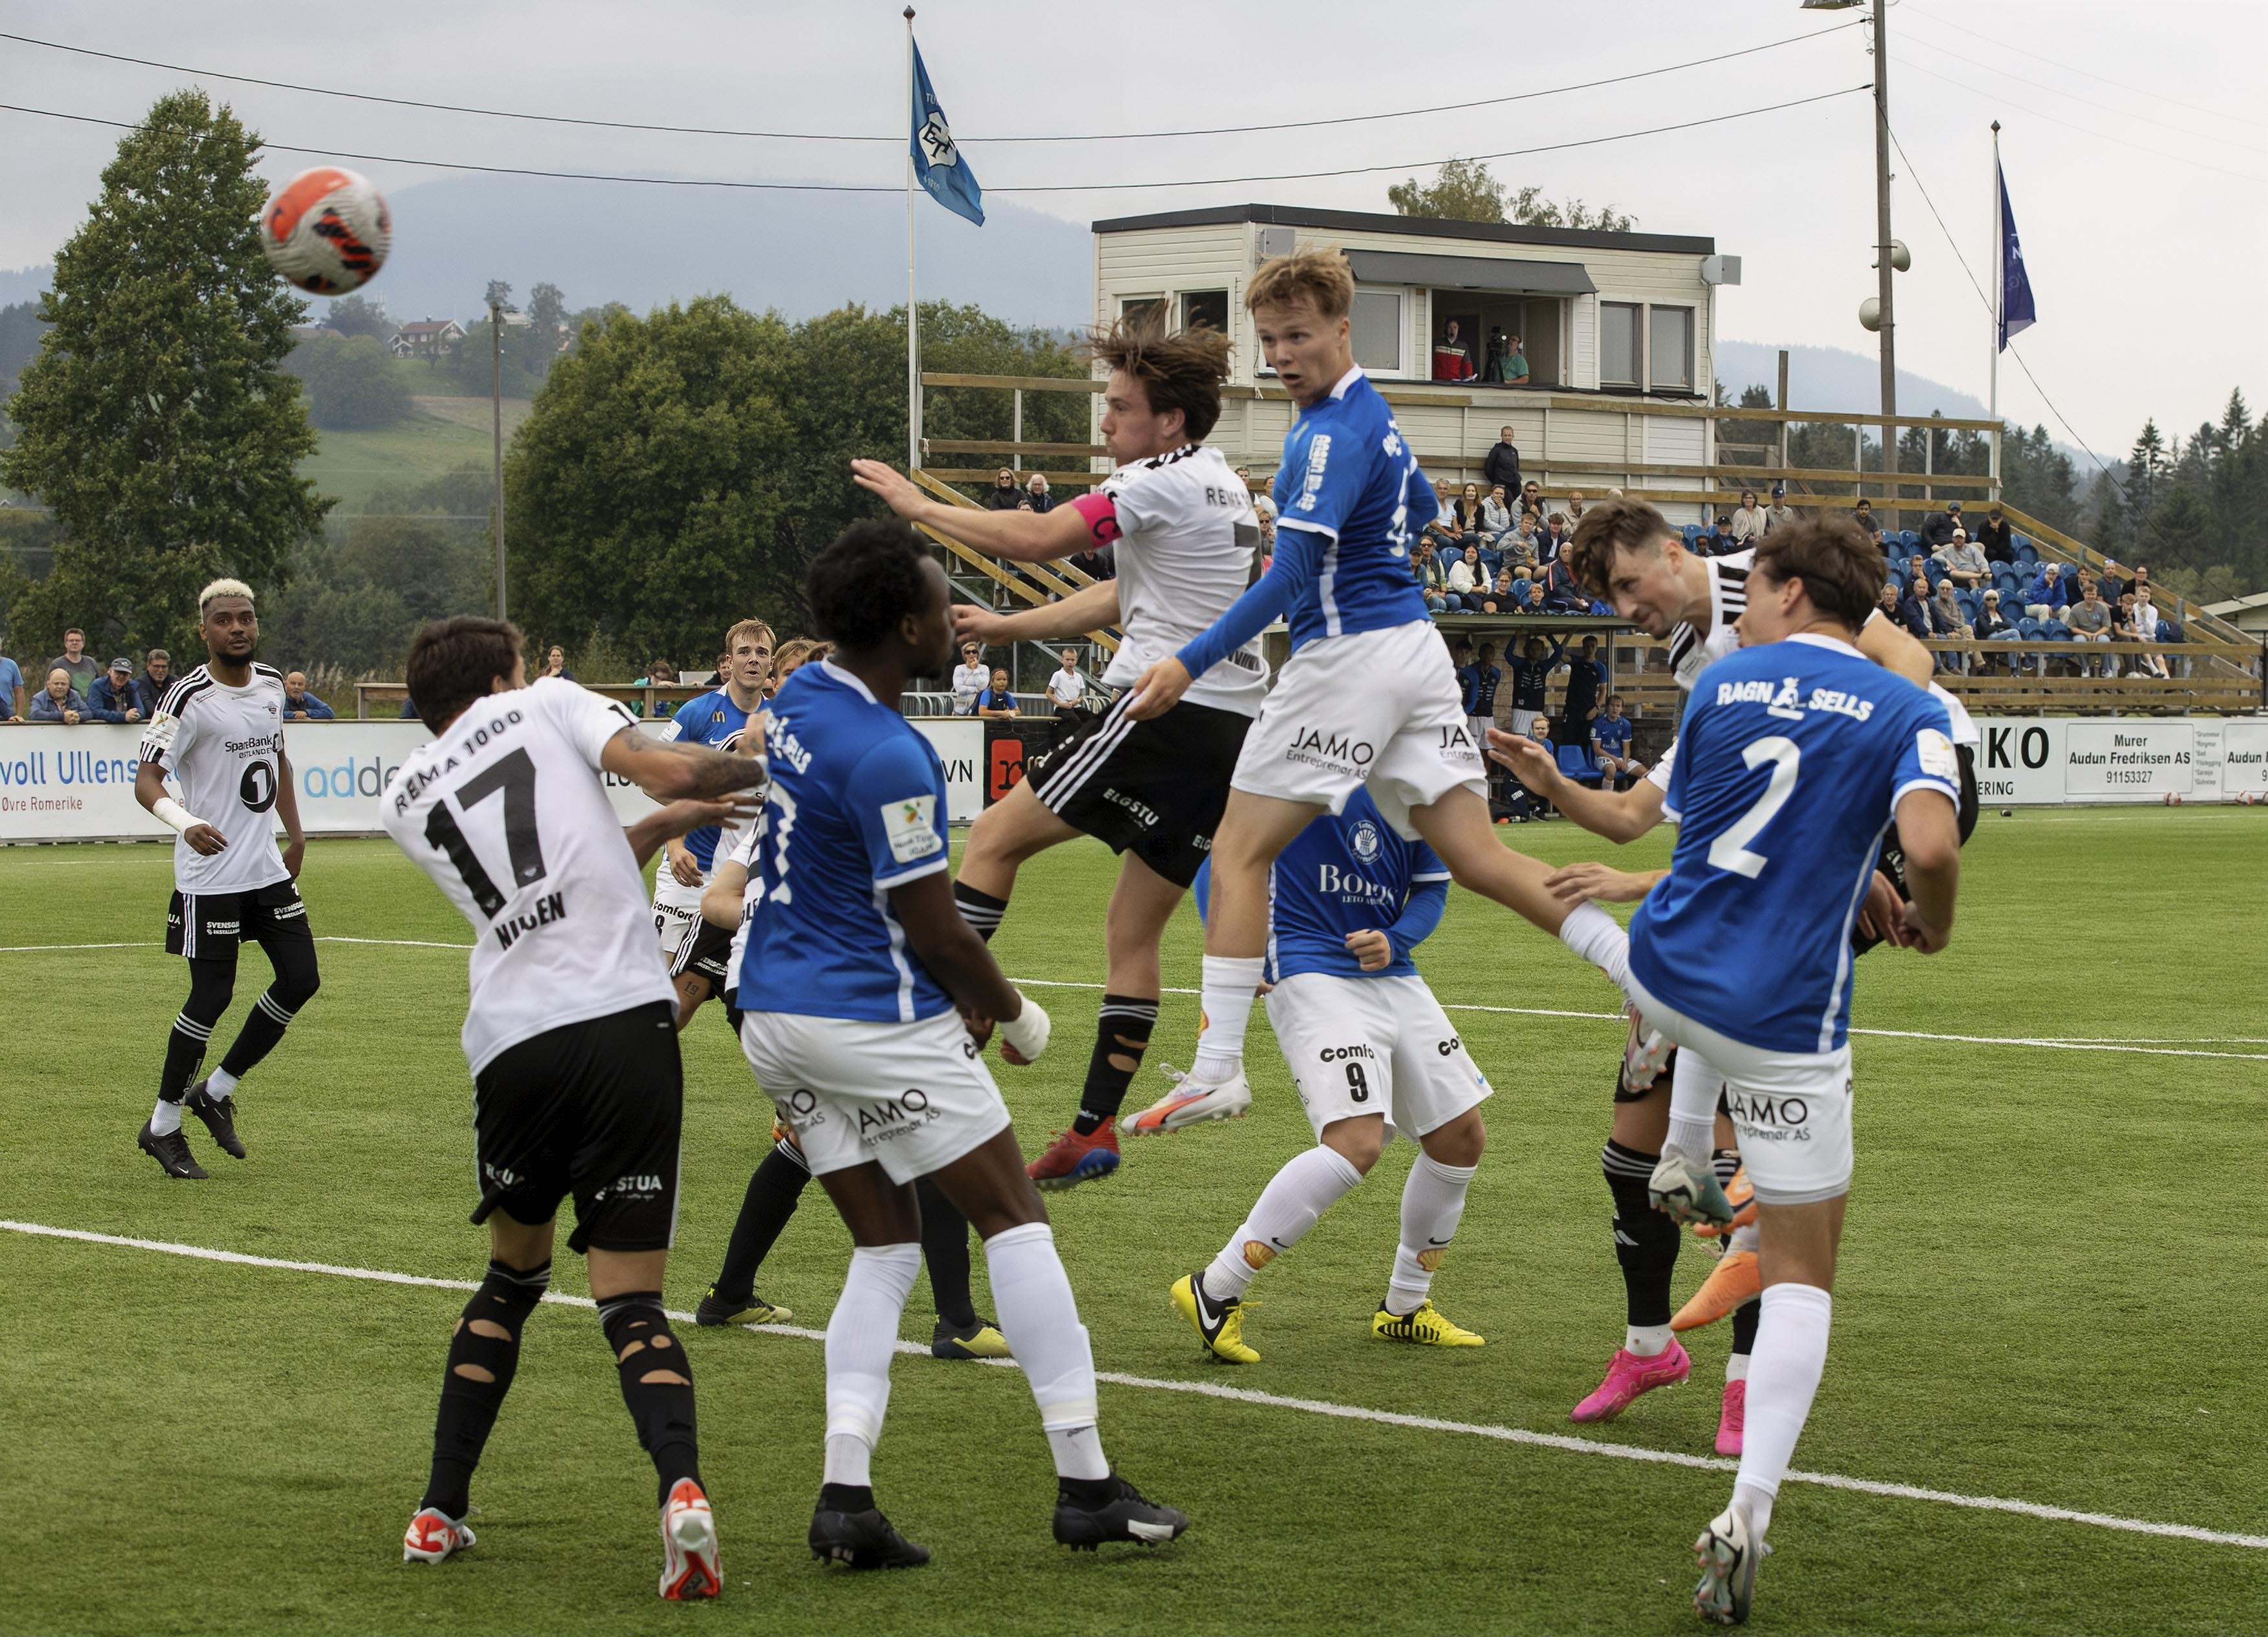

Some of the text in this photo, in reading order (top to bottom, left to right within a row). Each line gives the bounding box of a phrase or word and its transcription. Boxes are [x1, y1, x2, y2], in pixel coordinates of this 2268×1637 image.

[1716, 681, 1874, 722] RAGN SELLS
[1290, 726, 1374, 765] JAMO
[1968, 726, 2049, 769] KO
[2069, 752, 2191, 764] Audun Fredriksen AS
[2114, 735, 2147, 747] Murer
[2227, 751, 2262, 764] Audun
[395, 711, 522, 818] REMA 1000
[2107, 771, 2153, 783] 91153327
[2, 796, 83, 811] Øvre Romerike
[1707, 736, 1801, 880] 2
[424, 747, 546, 921] 17
[1345, 1062, 1369, 1103] 9
[844, 1088, 928, 1134] AMO
[1793, 1128, 1811, 1141] AS
